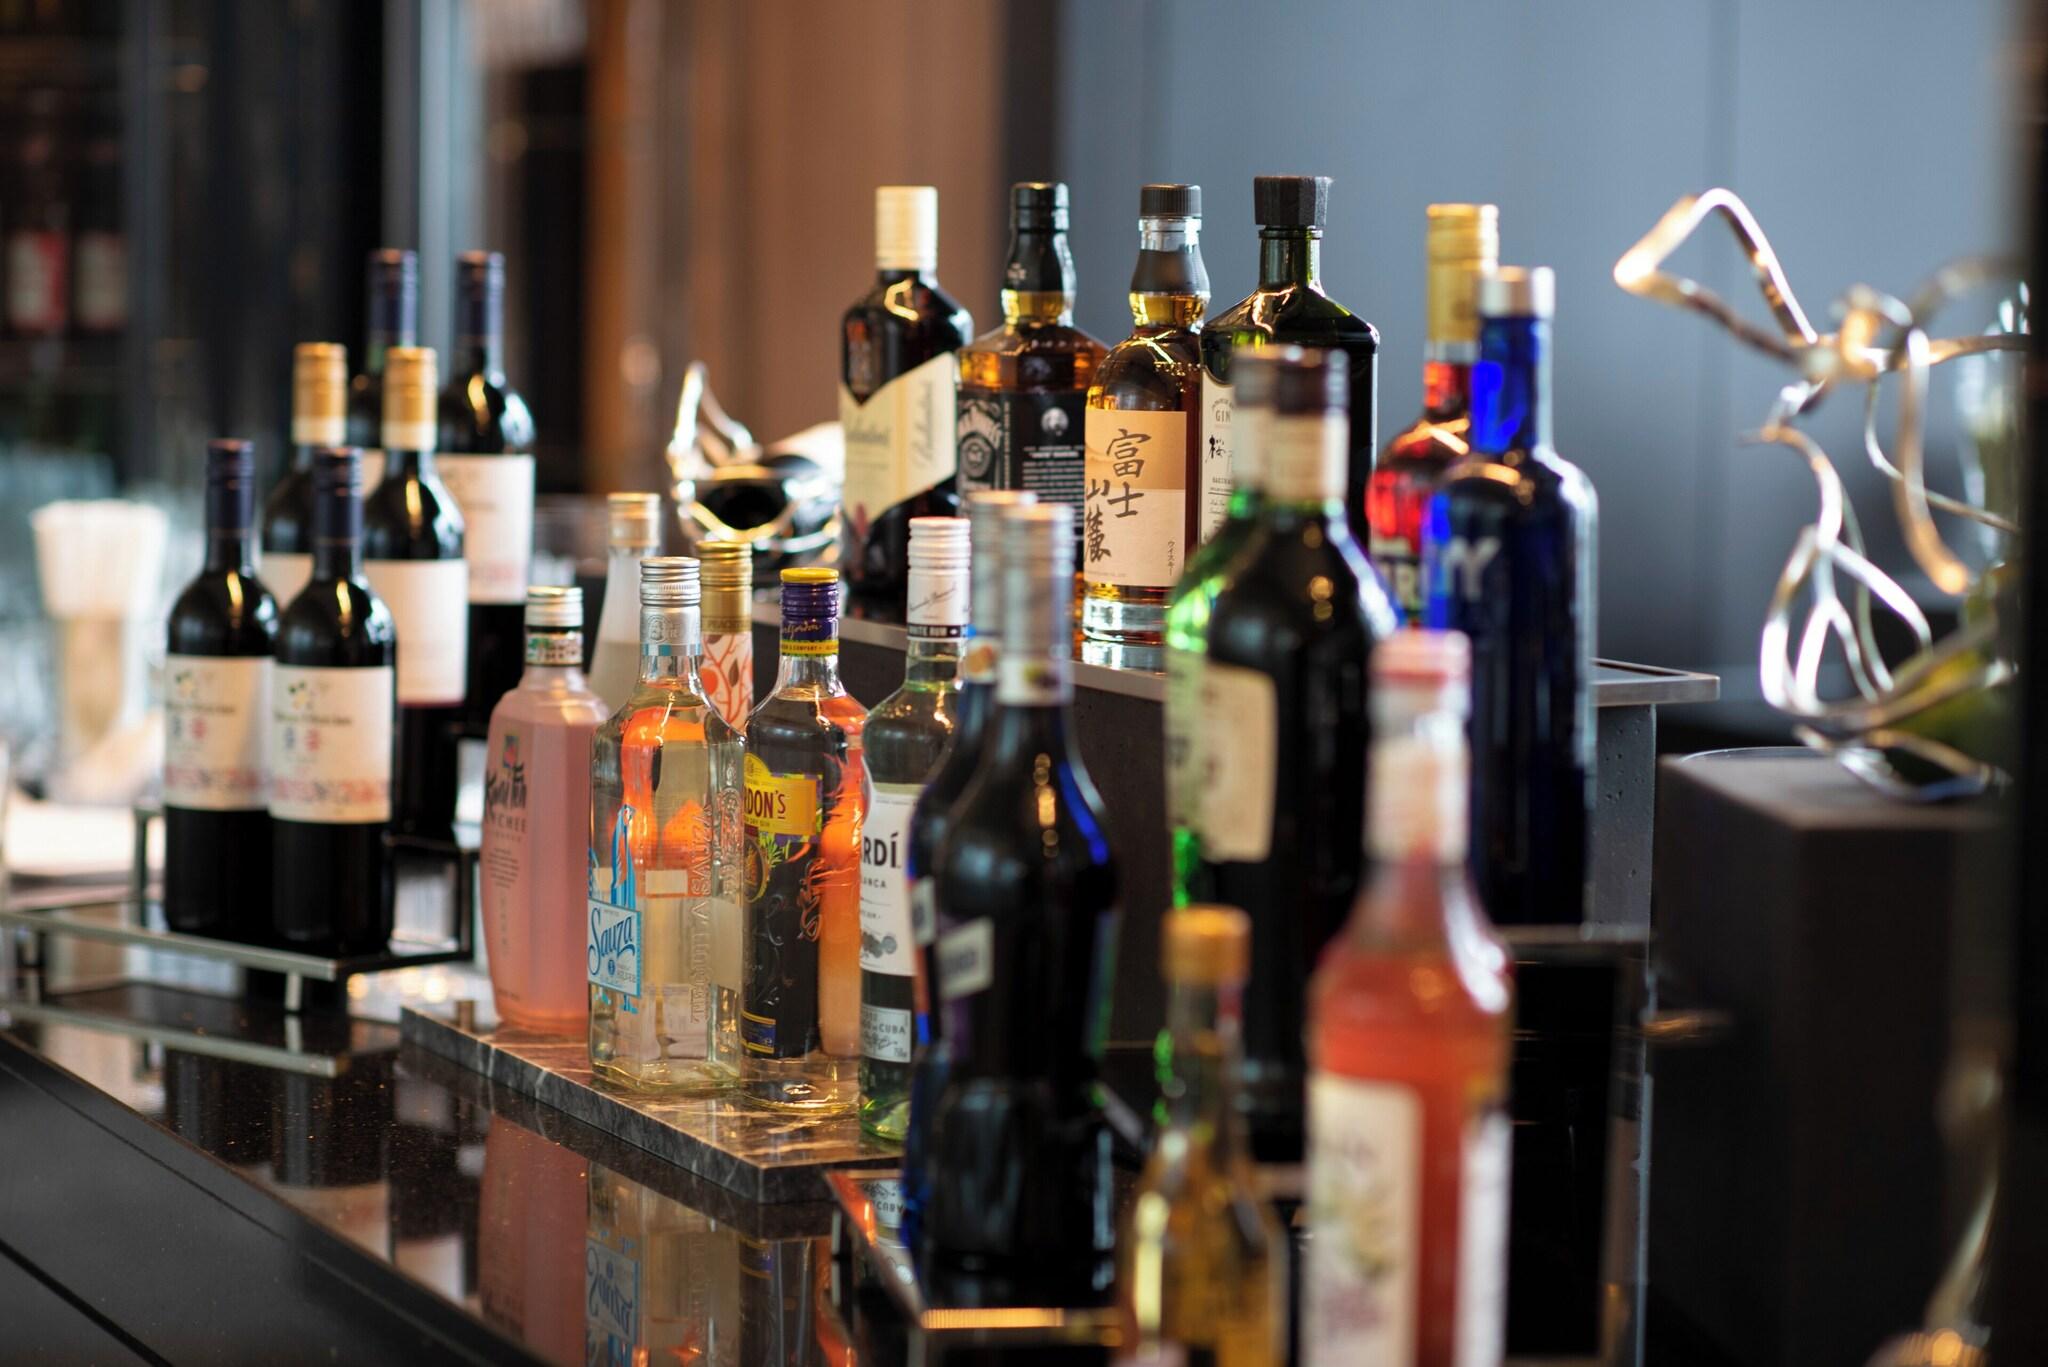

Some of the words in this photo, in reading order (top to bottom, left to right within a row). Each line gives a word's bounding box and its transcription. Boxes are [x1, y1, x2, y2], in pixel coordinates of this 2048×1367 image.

[1106, 428, 1152, 518] 富士
[587, 907, 636, 976] Sauza
[879, 1023, 906, 1034] CUBA
